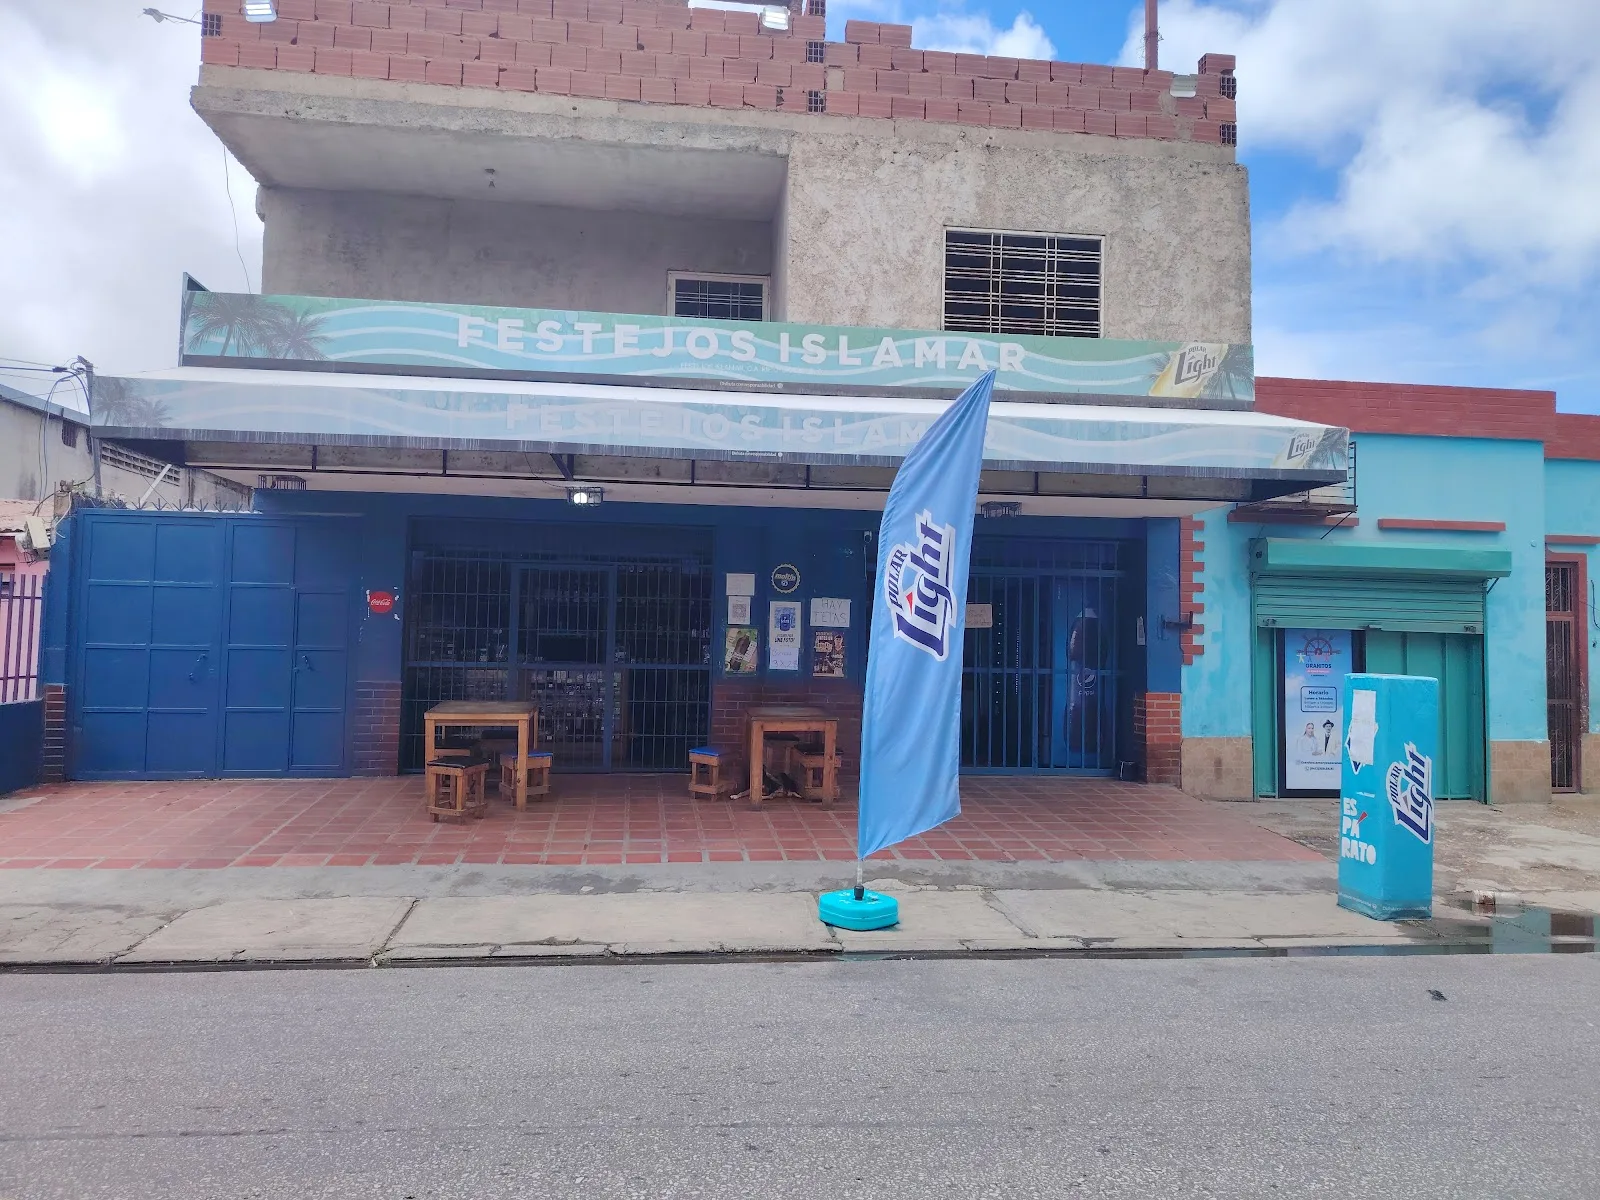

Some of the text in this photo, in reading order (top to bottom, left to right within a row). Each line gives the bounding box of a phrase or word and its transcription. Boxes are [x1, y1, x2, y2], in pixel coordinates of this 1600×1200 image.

[458, 315, 1026, 372] FESTEJOS ISLAMAR
[1188, 345, 1207, 355] POLAR
[1174, 352, 1217, 385] Light
[507, 403, 761, 441] FESTEJOS
[1287, 437, 1316, 461] Light
[888, 549, 909, 611] POLAR
[896, 518, 953, 657] Light
[821, 599, 843, 610] HAY
[1390, 765, 1403, 806] POLAR
[1396, 750, 1433, 841] Light
[1343, 797, 1357, 816] ES
[1341, 837, 1376, 865] RATO
